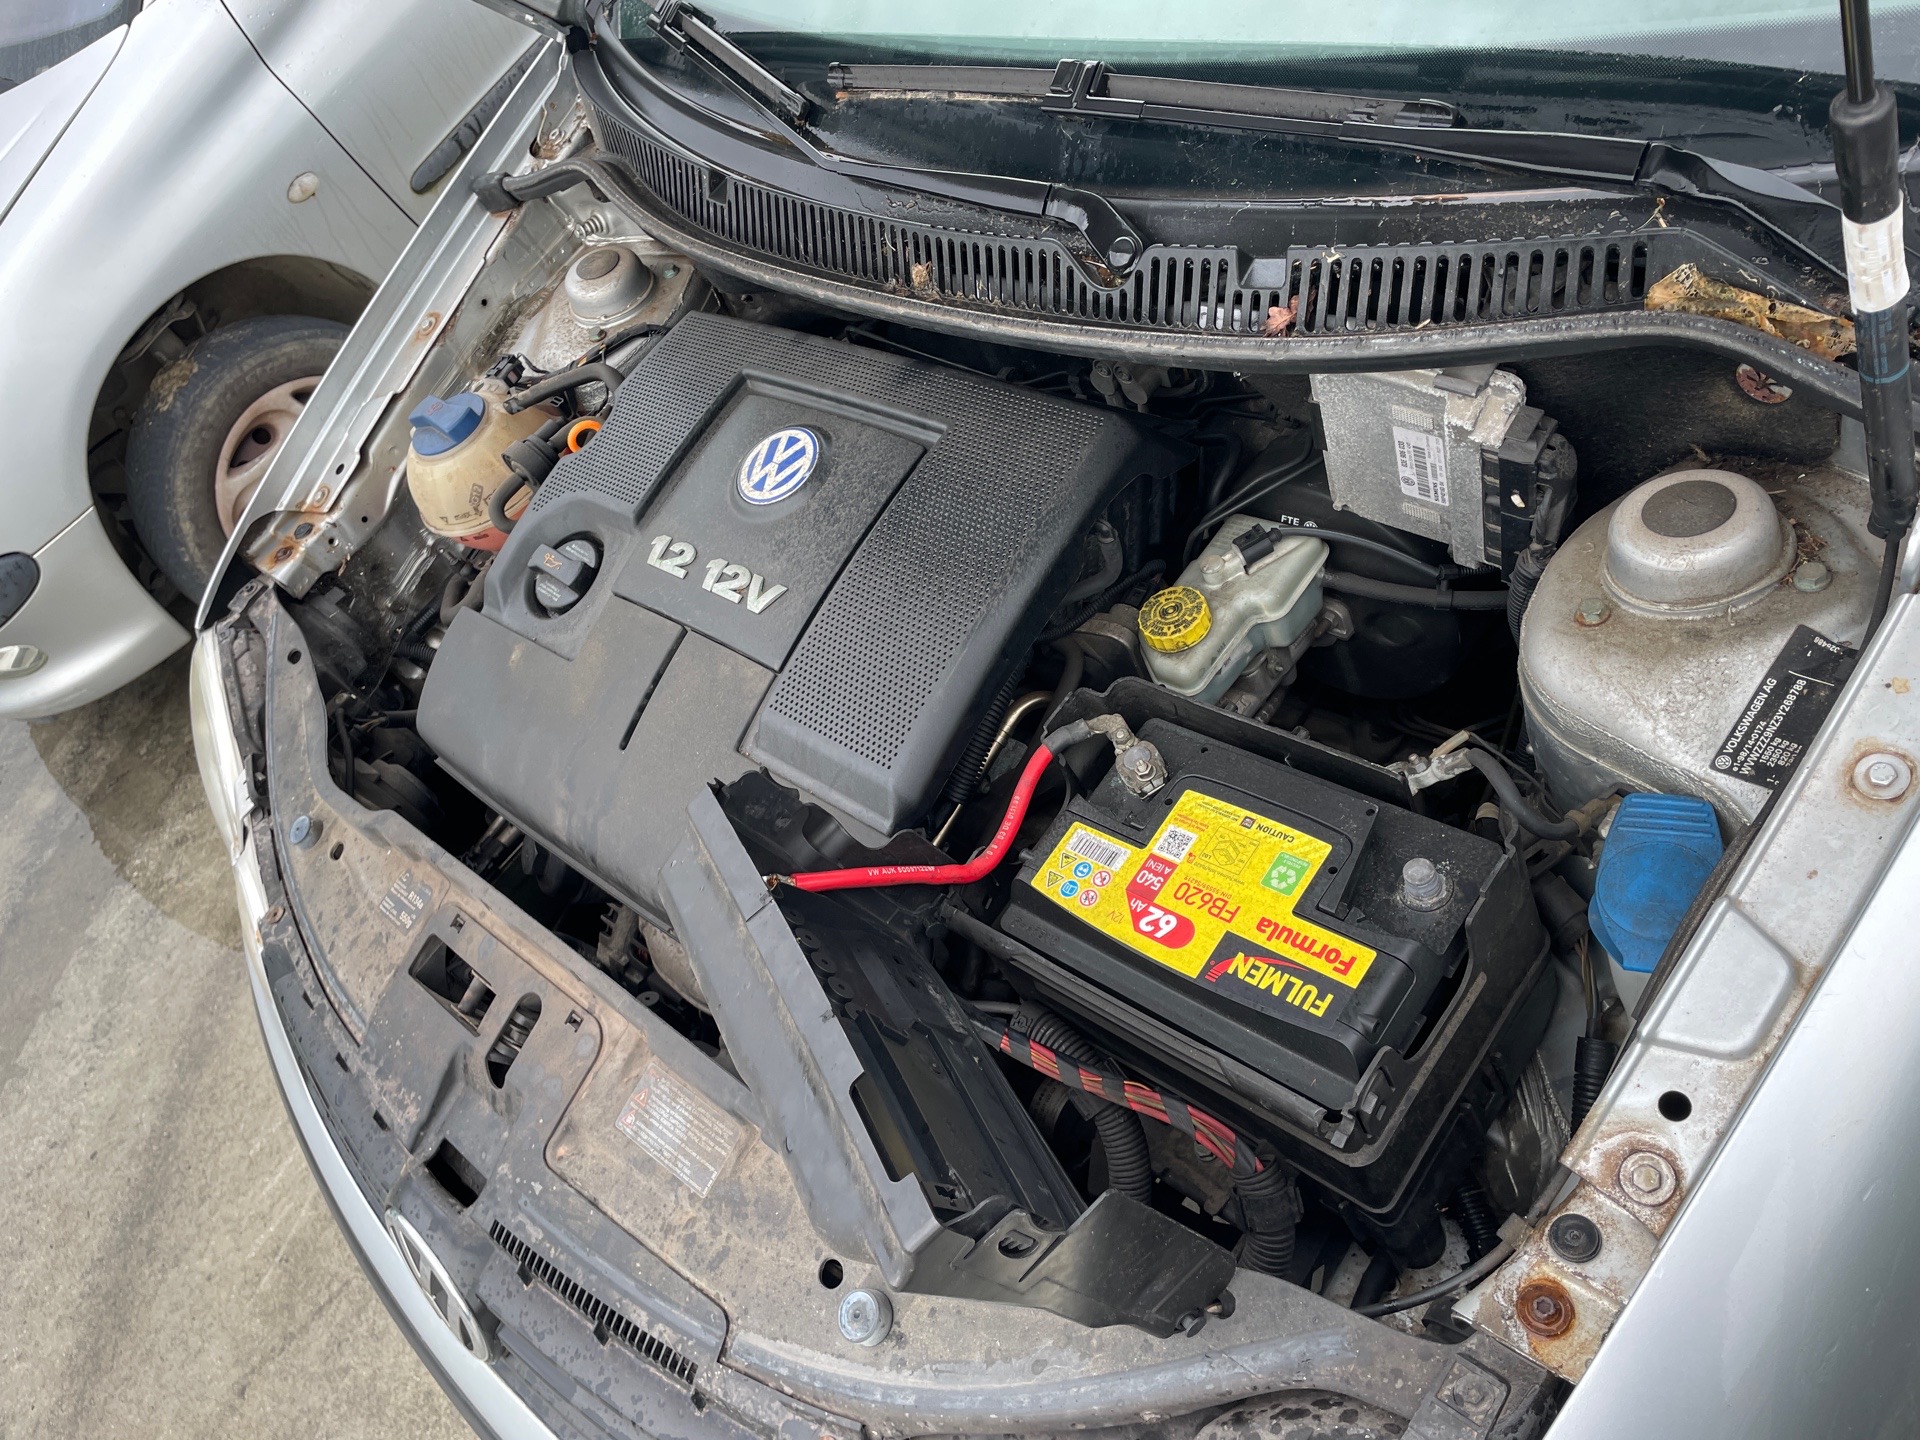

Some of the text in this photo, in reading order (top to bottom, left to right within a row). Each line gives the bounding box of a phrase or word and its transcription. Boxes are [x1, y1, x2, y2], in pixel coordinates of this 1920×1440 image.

[1281, 514, 1300, 526] FTE
[702, 558, 789, 614] 12V
[1723, 676, 1777, 753] VOLKSWAGEN AG
[1767, 748, 1783, 767] 2350
[1778, 740, 1790, 749] kg
[1770, 737, 1782, 746] kg
[1778, 752, 1791, 766] 820
[1786, 743, 1798, 752] kg
[1256, 823, 1295, 842] CAUTION
[1136, 869, 1165, 890] 540
[408, 890, 424, 910] R134a
[1174, 882, 1242, 924] FB620
[1130, 897, 1178, 939] 62 Ah
[1255, 915, 1357, 976] Formula
[1225, 951, 1334, 1018] FULMEN
